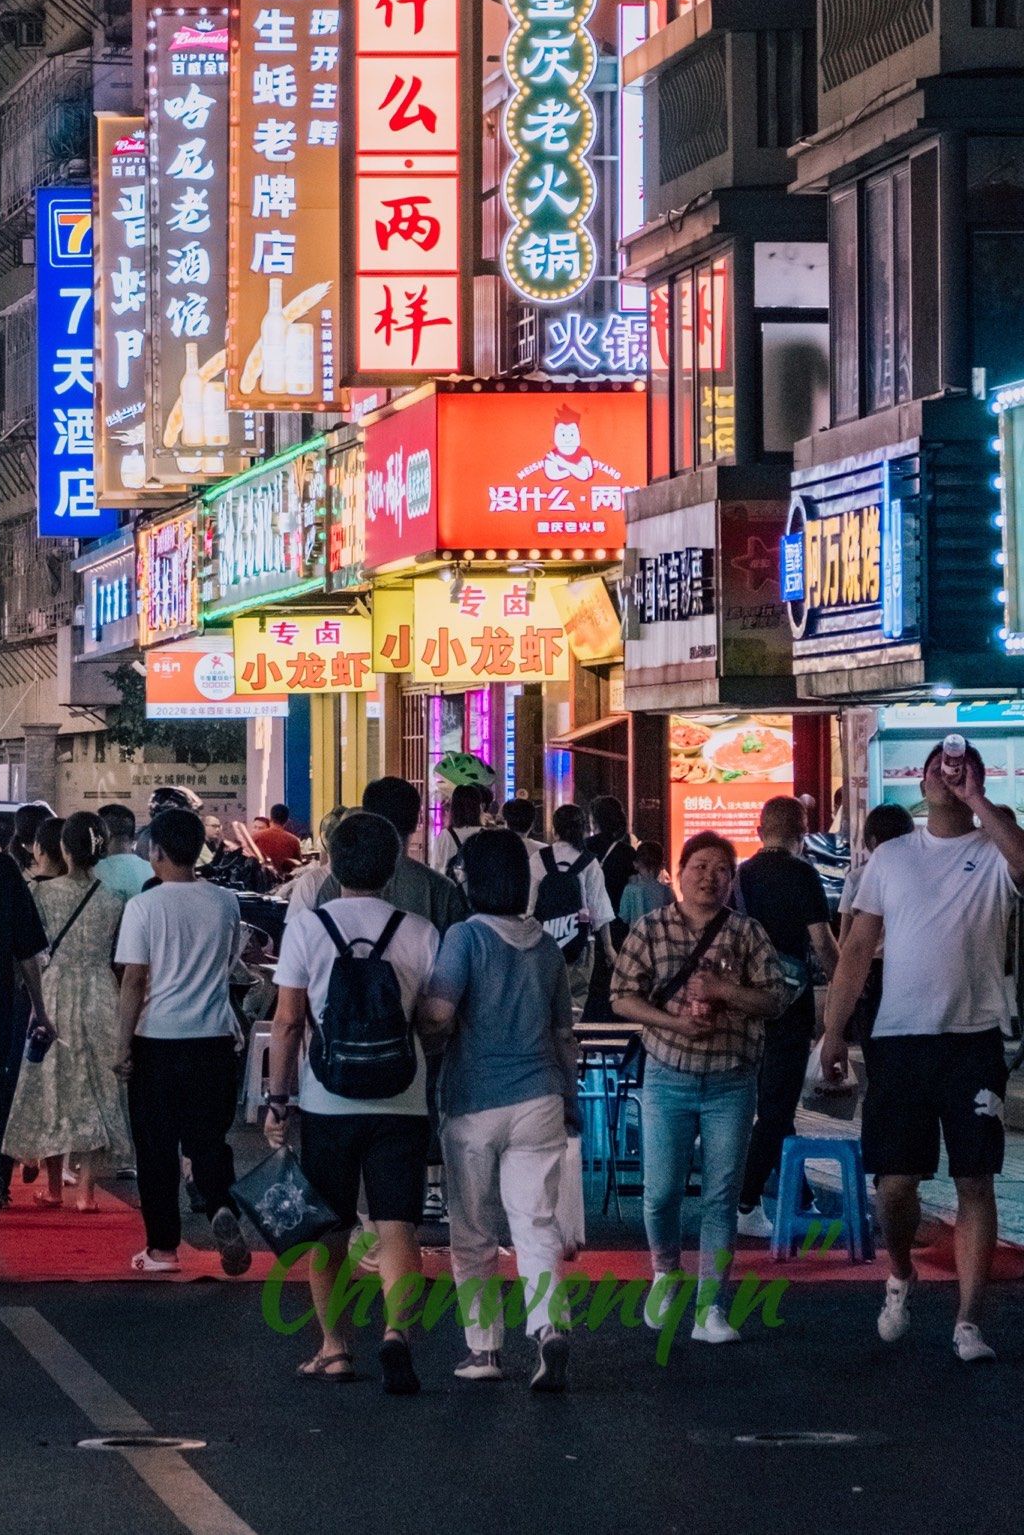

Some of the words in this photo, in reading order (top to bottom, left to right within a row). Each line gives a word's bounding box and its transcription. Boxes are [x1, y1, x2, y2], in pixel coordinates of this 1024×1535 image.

[172, 53, 224, 61] SUPREM
[252, 8, 299, 276] 生蚝老牌店
[545, 313, 647, 371] 火锅
[52, 288, 101, 518] 7天酒店
[488, 486, 641, 512] 没什么·两
[633, 549, 704, 623] 中国体育彩票
[241, 651, 371, 691] 小龙虾
[421, 625, 563, 677] 小龙虾
[543, 912, 579, 939] NIKE
